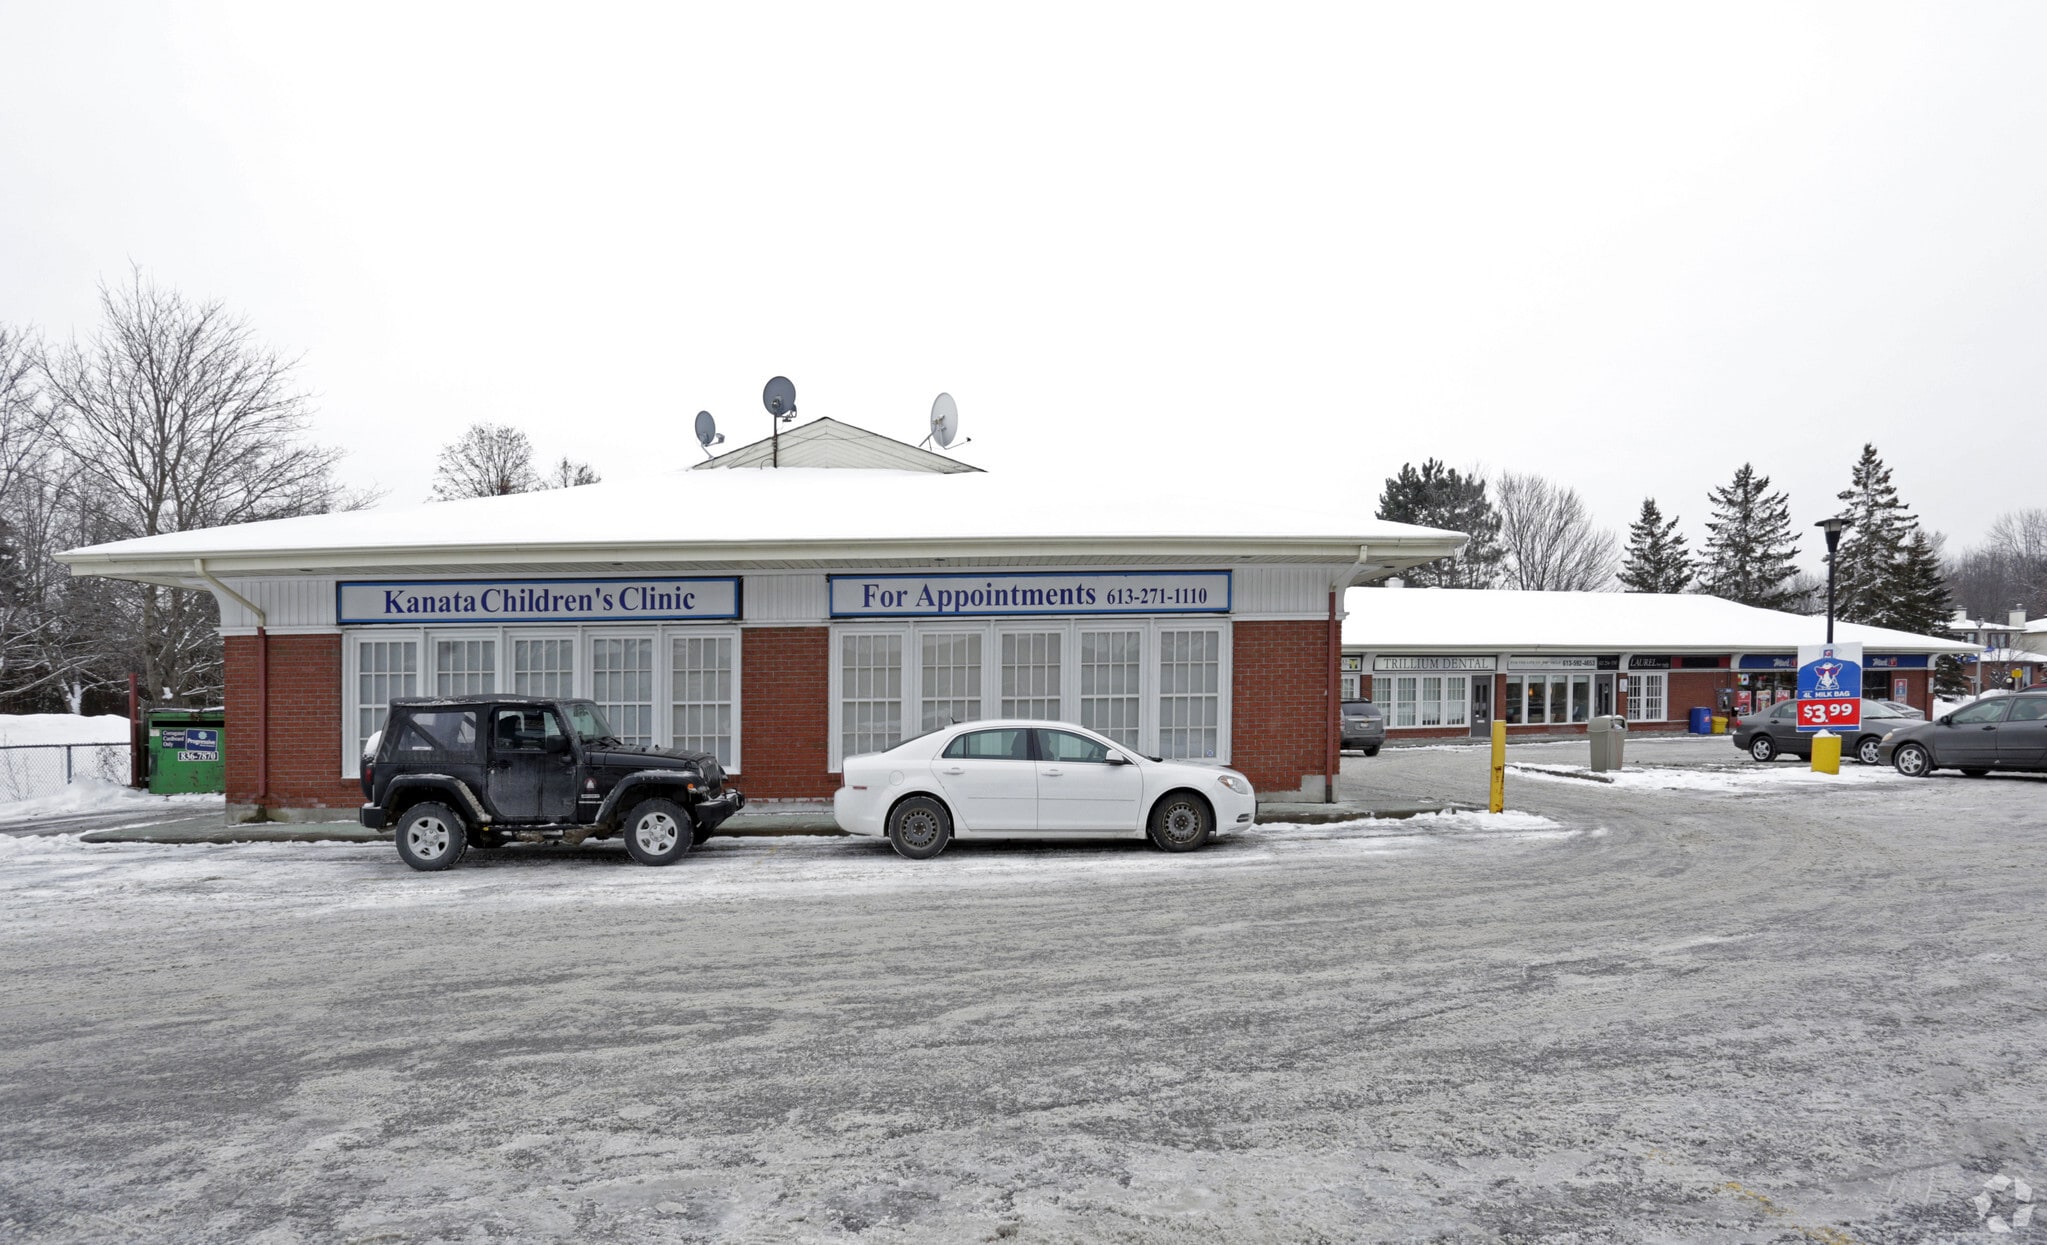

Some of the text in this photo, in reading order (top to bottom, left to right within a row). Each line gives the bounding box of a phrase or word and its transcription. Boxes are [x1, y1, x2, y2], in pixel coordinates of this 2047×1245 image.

[384, 586, 696, 614] Kanata Children's Clinic
[862, 582, 1208, 613] For Appointments 613-271-1110
[1384, 657, 1489, 669] TRILLIUM DENTAL
[1630, 658, 1657, 667] LAUREL
[1834, 690, 1850, 698] BAG
[1803, 704, 1853, 723] $3.99
[180, 752, 216, 760] 836-7870
